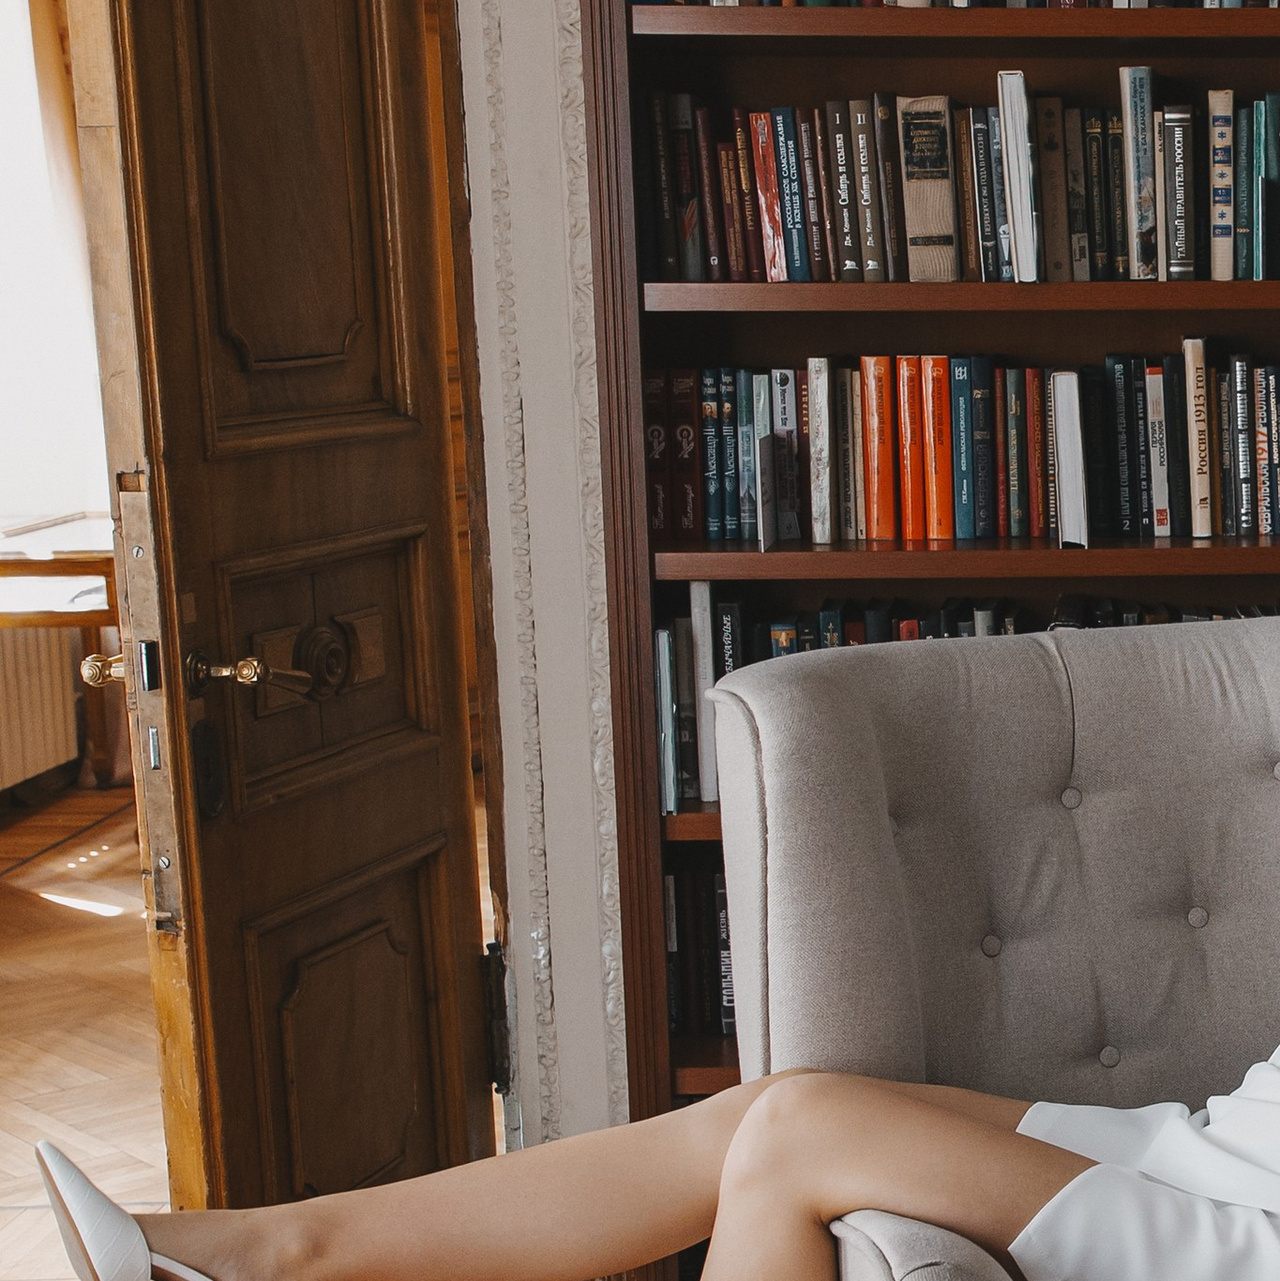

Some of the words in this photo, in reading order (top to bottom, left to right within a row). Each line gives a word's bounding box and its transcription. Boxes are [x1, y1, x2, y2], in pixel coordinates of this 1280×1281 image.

[835, 133, 846, 165] ссылка
[858, 133, 868, 165] ссылка
[1173, 127, 1184, 163] РОССИИ
[838, 173, 850, 205] Сибирь
[860, 173, 872, 205] Сибирь
[1175, 164, 1185, 216] ПРАВИТЕЛЬ
[1176, 219, 1186, 258] ТАЙНЫЙ
[1195, 366, 1208, 389] год
[1194, 394, 1205, 423] 1913
[1255, 368, 1267, 429] РЕВОЛЮЦИЯ
[706, 436, 719, 479] Александр
[724, 436, 736, 477] Александр
[1196, 429, 1208, 475] Россия
[1121, 487, 1131, 515] ПАРТИЯ
[1257, 462, 1272, 534] ФЕВРАЛЬСКАЯ
